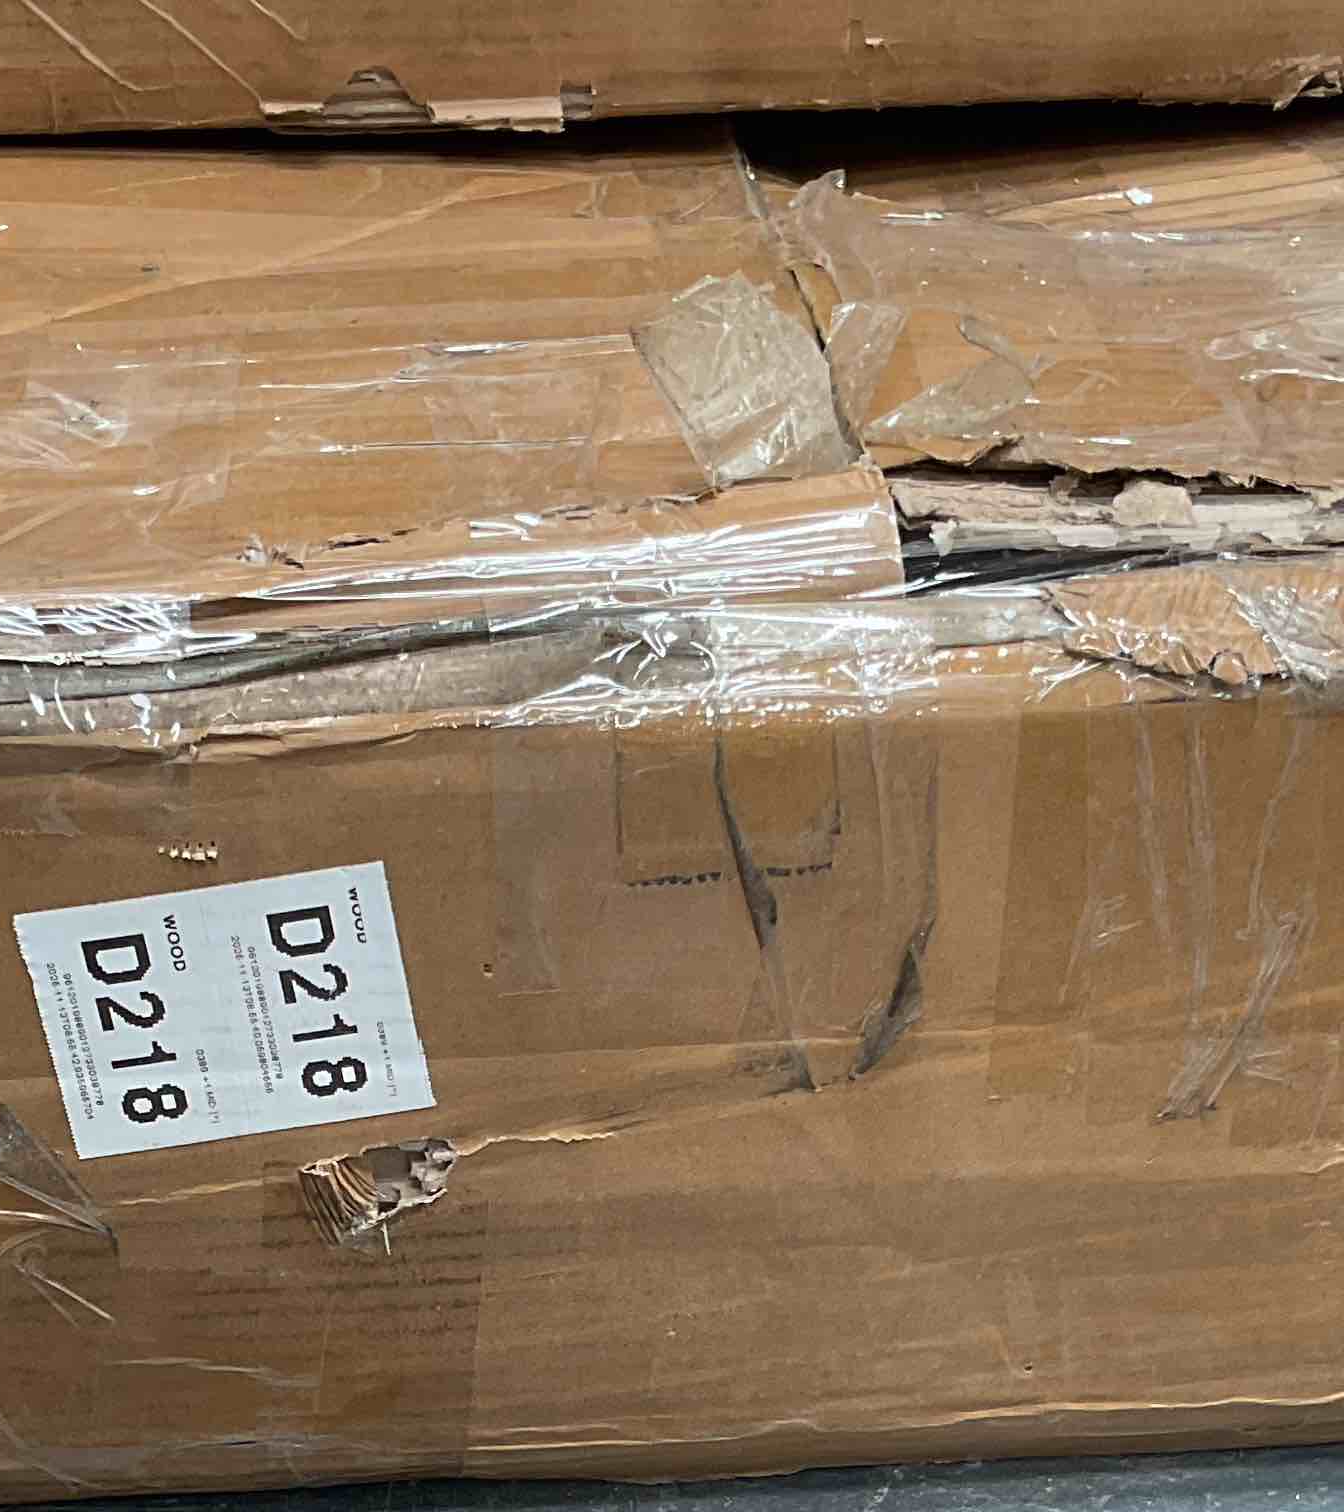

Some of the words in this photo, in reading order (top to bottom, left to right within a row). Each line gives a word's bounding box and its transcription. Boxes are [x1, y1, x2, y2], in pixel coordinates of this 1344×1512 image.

[164, 914, 186, 972] WOOD
[347, 887, 366, 944] WOOD
[81, 934, 190, 1124] D218
[265, 905, 368, 1098] D218
